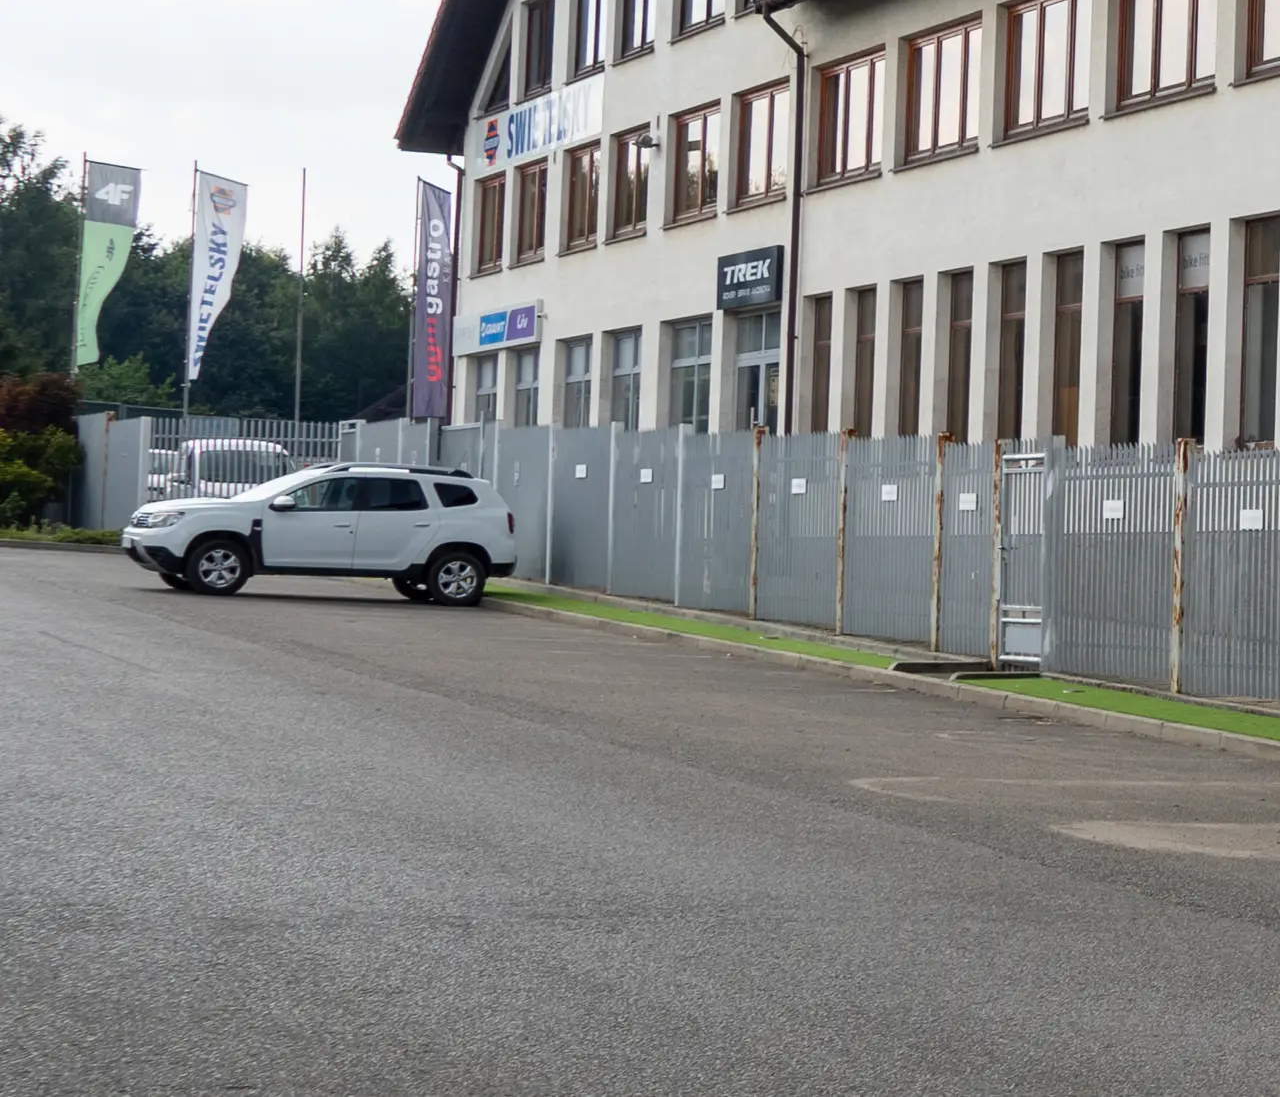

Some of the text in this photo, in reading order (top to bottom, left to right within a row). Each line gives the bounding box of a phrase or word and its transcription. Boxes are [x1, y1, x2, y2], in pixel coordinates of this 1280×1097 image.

[95, 182, 134, 206] 4F
[427, 218, 445, 315] gastro
[723, 258, 772, 286] TREK
